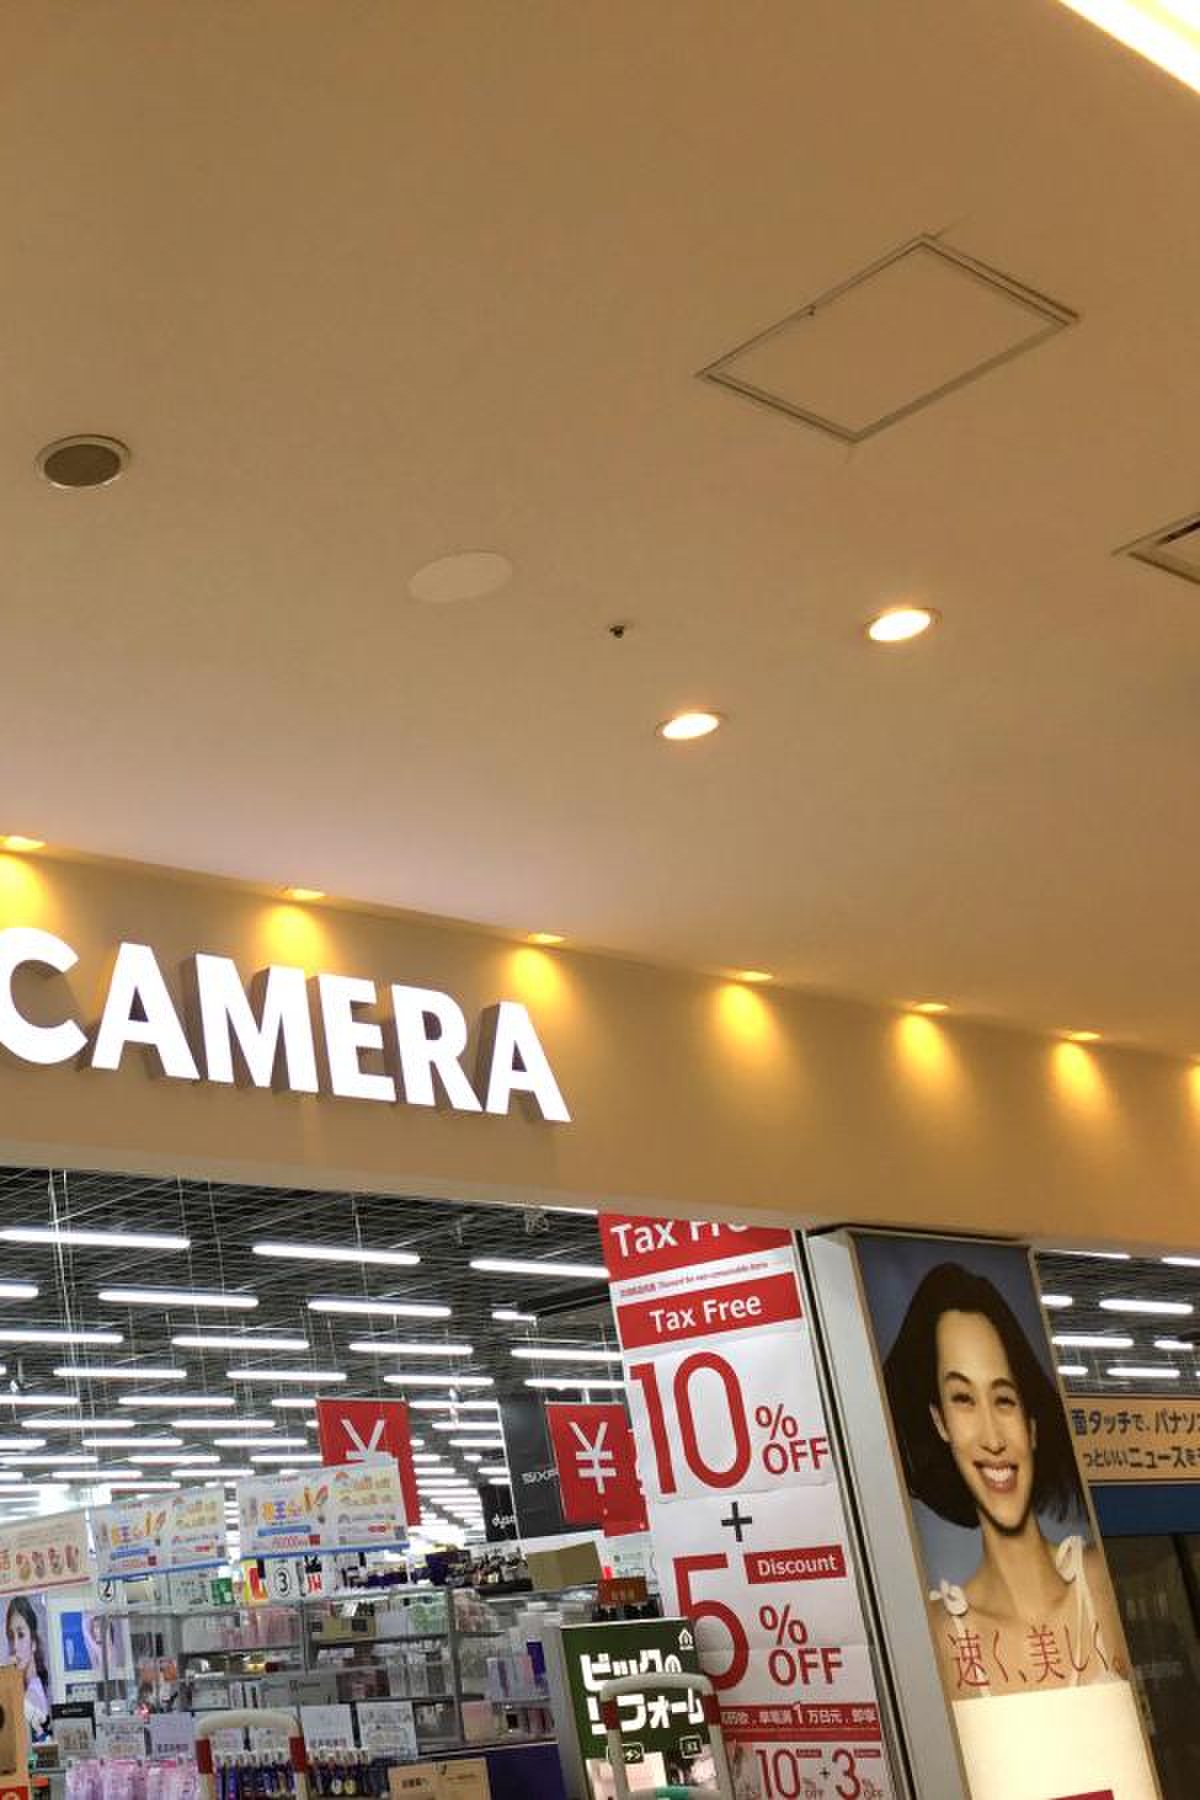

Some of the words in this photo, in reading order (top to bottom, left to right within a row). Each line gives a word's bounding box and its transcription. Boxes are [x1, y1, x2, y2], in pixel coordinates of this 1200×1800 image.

[610, 1220, 679, 1258] Tax
[649, 1308, 697, 1334] Tax
[702, 1294, 763, 1325] Free
[629, 1351, 752, 1494] 10
[762, 1437, 829, 1476] OFF
[757, 1553, 839, 1577] Discount
[672, 1552, 750, 1692] 5
[768, 1646, 843, 1687] OFF
[755, 1749, 801, 1800] 10
